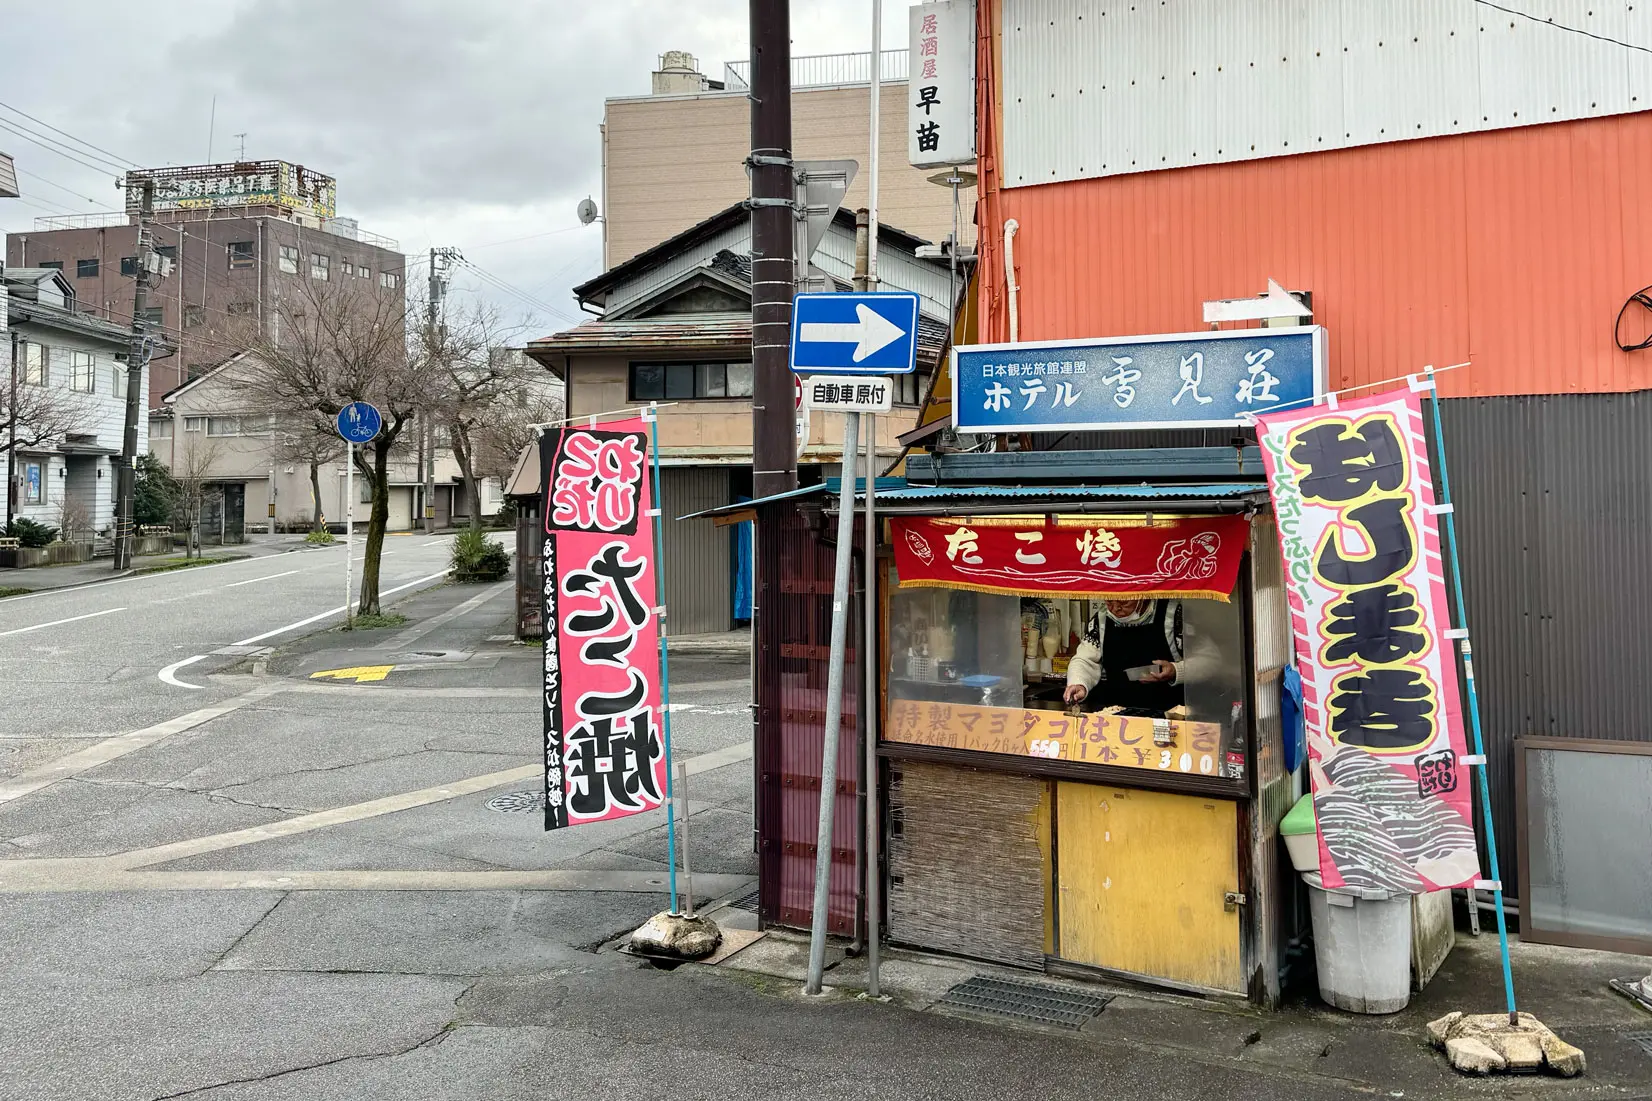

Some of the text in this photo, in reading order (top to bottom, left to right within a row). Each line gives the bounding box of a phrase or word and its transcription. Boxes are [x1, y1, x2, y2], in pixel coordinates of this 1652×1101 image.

[916, 13, 941, 153] 居酒屋 早苗
[982, 360, 1087, 378] 日本観光旅館連盟
[983, 348, 1281, 412] ホテル 雪見荘
[944, 526, 1122, 568] たこ焼
